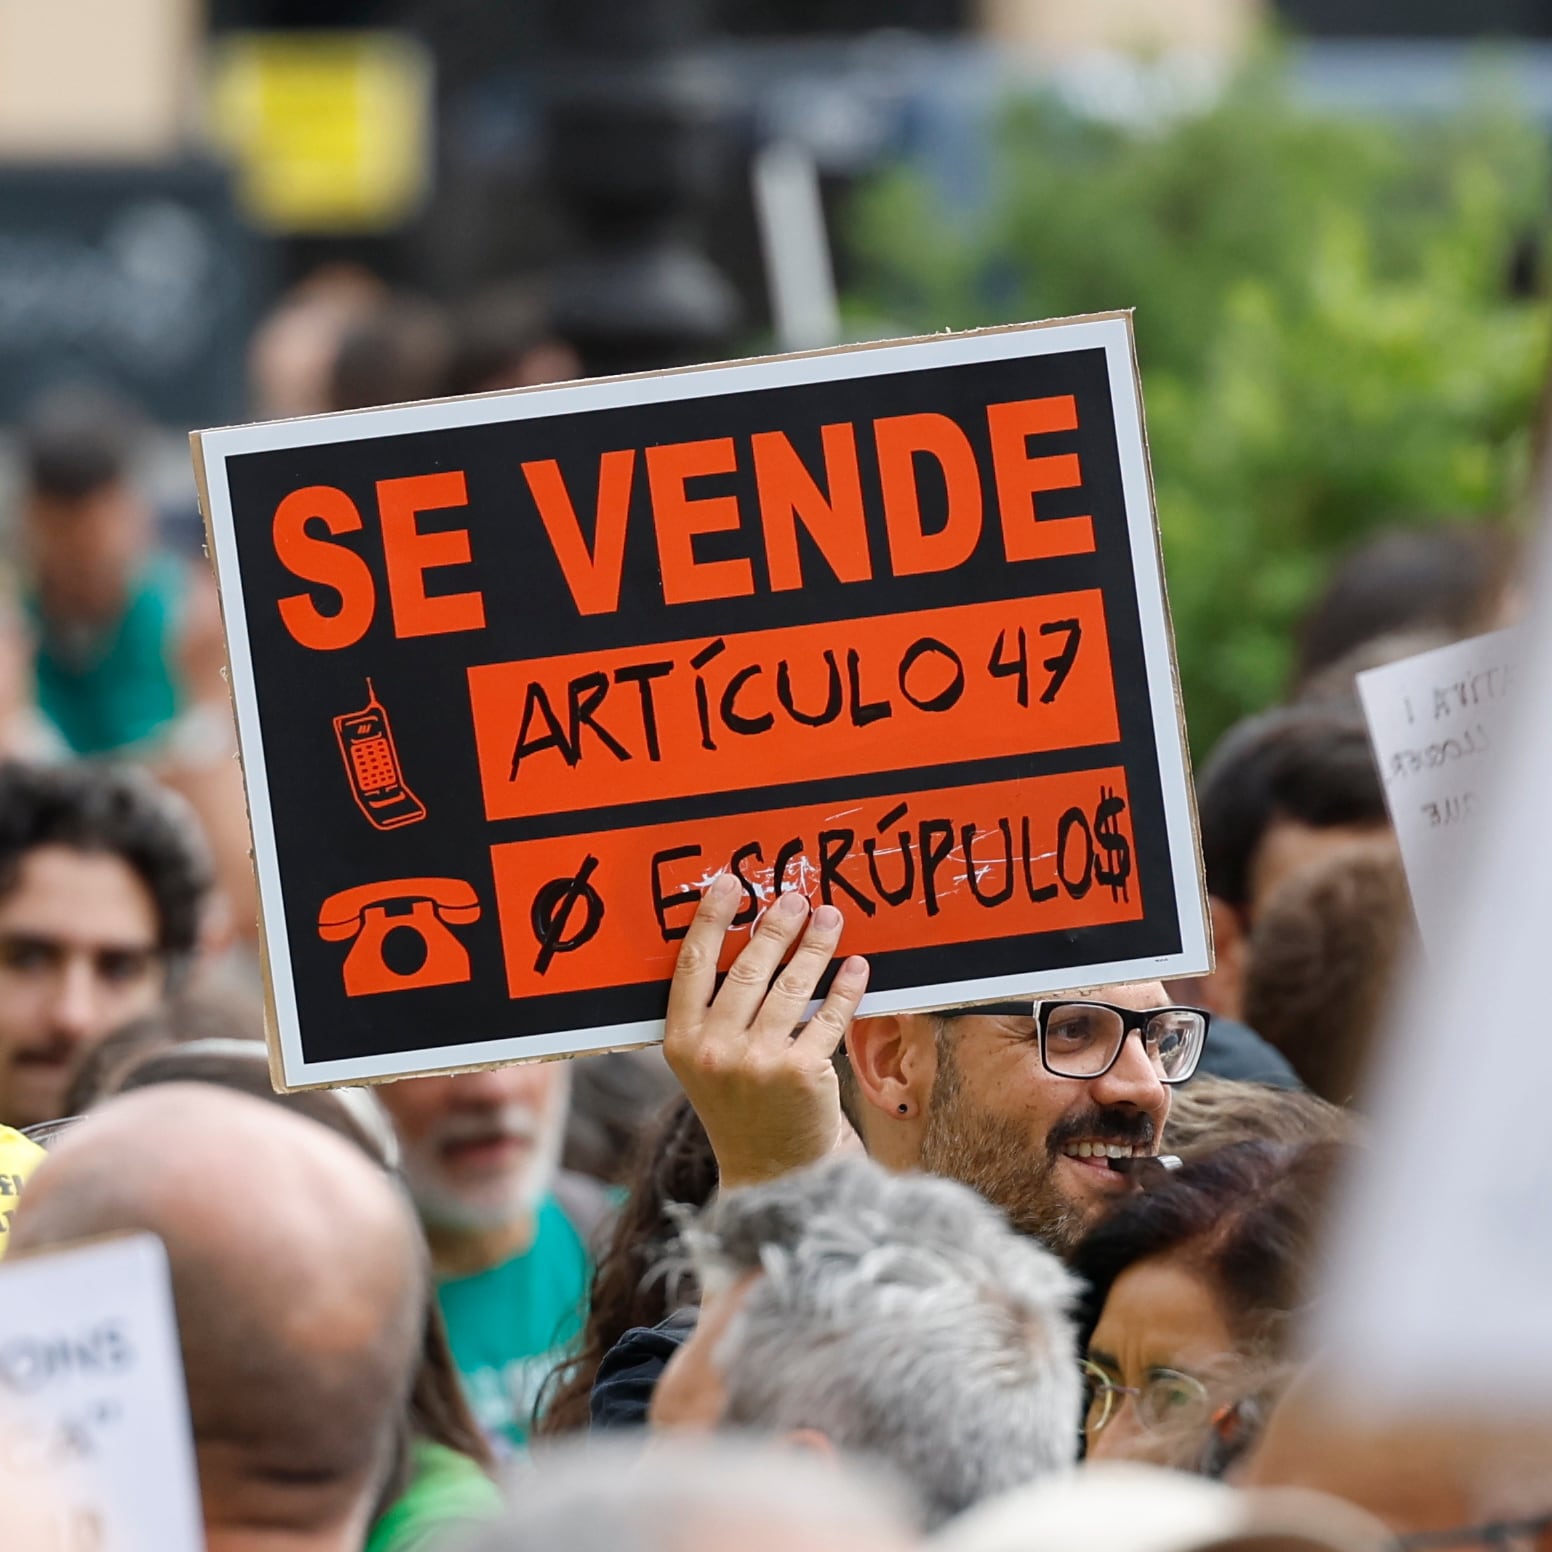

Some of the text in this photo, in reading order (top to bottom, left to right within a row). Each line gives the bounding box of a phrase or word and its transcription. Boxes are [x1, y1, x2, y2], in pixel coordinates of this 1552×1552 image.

[271, 394, 1097, 652] SE VENDE
[509, 618, 1082, 782] ARTÍCULO 47
